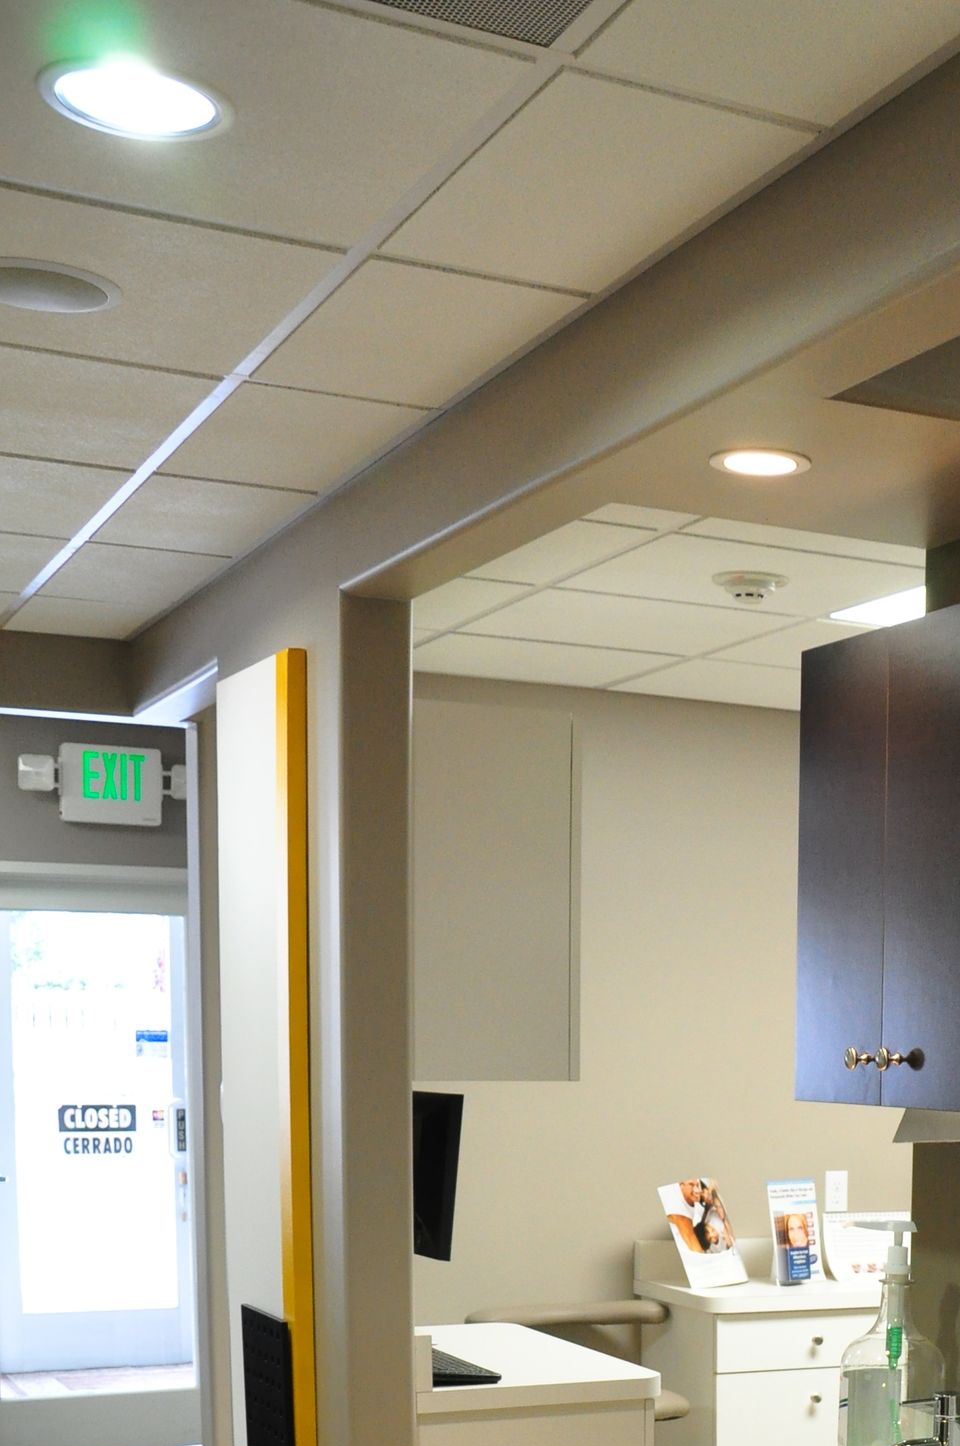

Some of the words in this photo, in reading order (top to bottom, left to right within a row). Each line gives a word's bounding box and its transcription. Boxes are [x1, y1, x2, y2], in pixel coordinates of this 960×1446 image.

[82, 750, 146, 802] EXIT
[63, 1107, 132, 1129] CLOSED
[177, 1109, 186, 1151] PUSH
[63, 1137, 133, 1154] CERRADO
